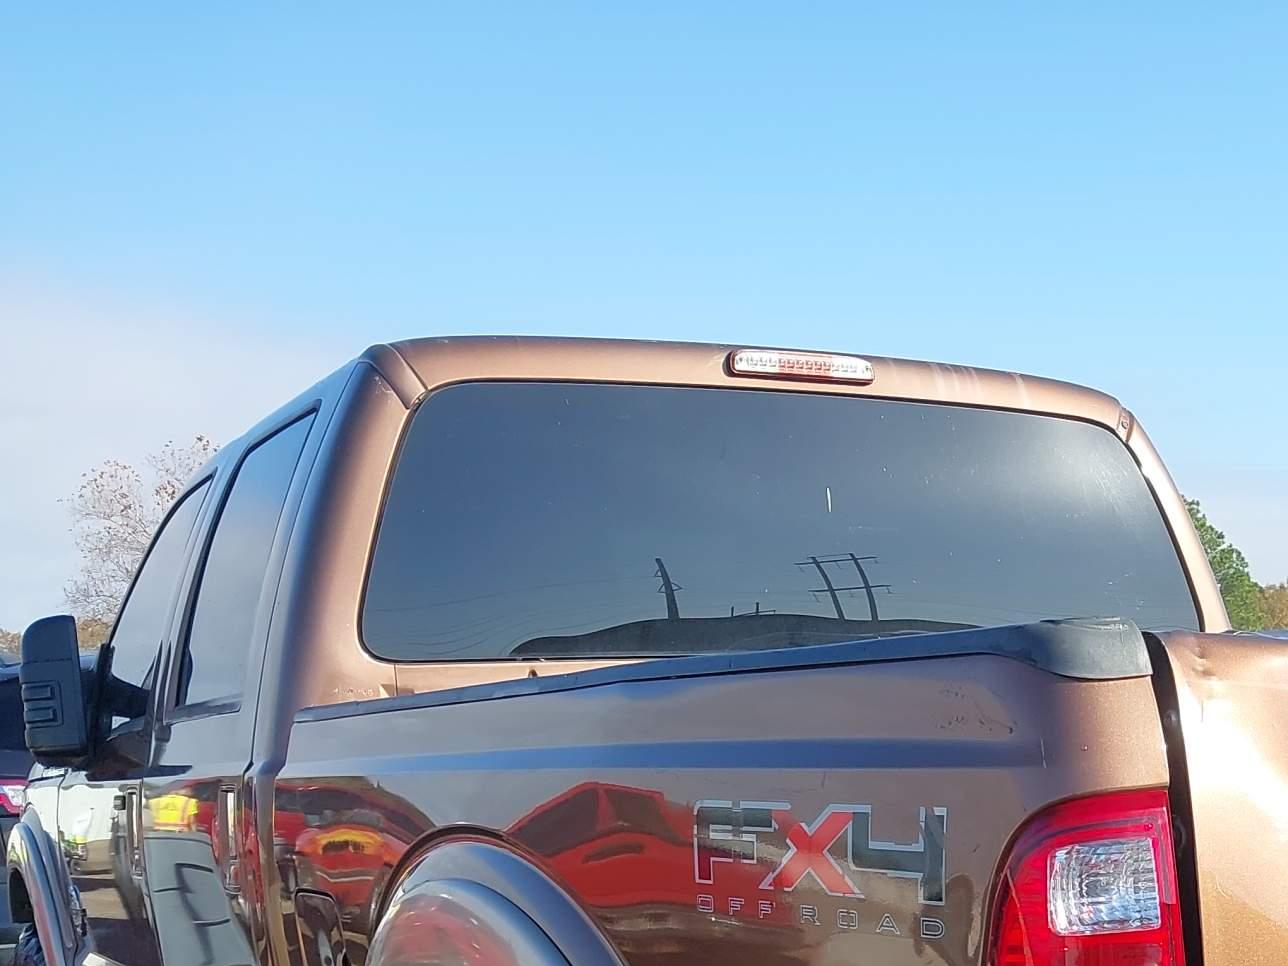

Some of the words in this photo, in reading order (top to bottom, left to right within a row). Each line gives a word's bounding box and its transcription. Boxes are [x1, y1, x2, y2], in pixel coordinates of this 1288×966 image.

[694, 800, 948, 905] FX4
[696, 894, 775, 919] OFF
[801, 905, 945, 939] ROAD
